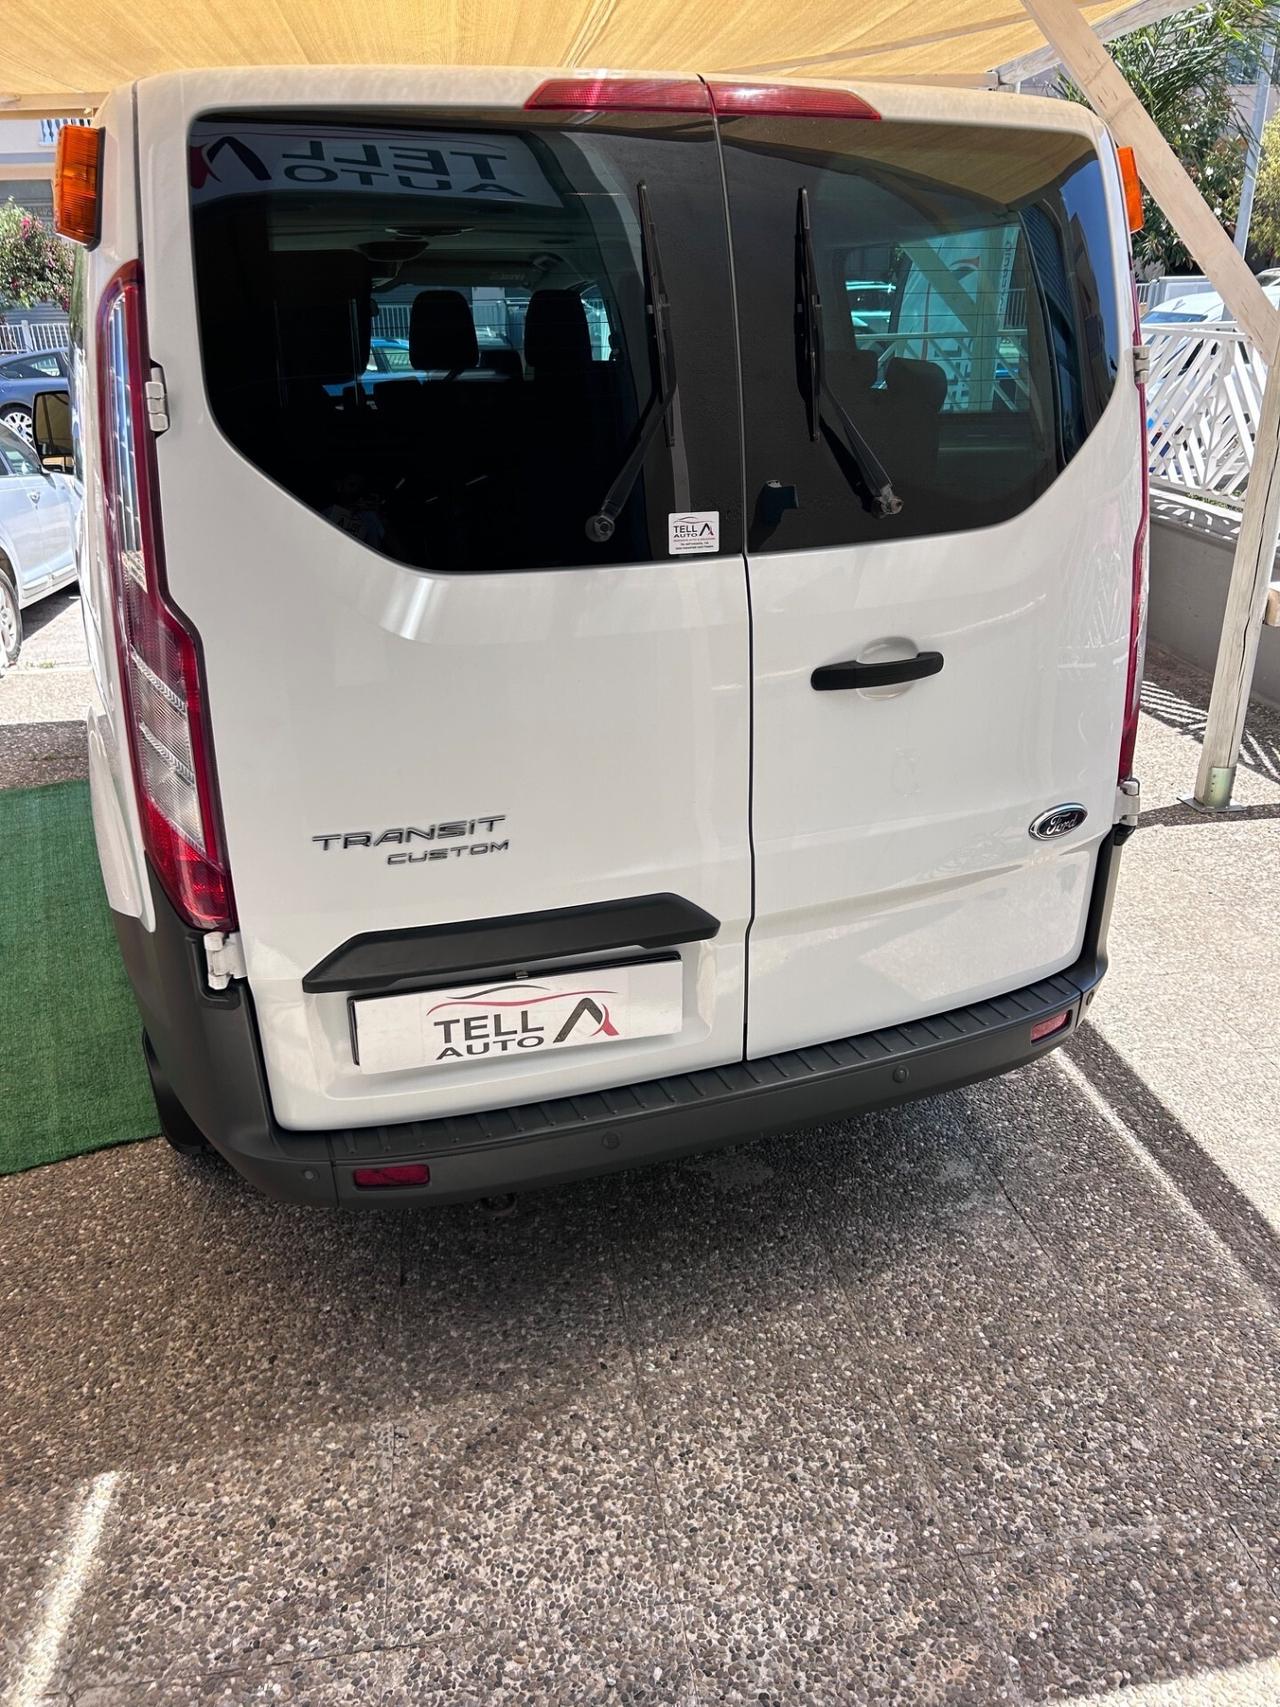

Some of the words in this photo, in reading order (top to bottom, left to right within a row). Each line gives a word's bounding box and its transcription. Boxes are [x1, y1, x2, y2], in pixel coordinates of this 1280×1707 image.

[673, 525, 698, 533] TELL
[312, 815, 506, 851] TRANSIT
[1047, 812, 1078, 835] Ford
[387, 839, 510, 865] CUSTOM
[433, 1010, 544, 1044] TELL
[435, 1035, 544, 1060] AUTO
